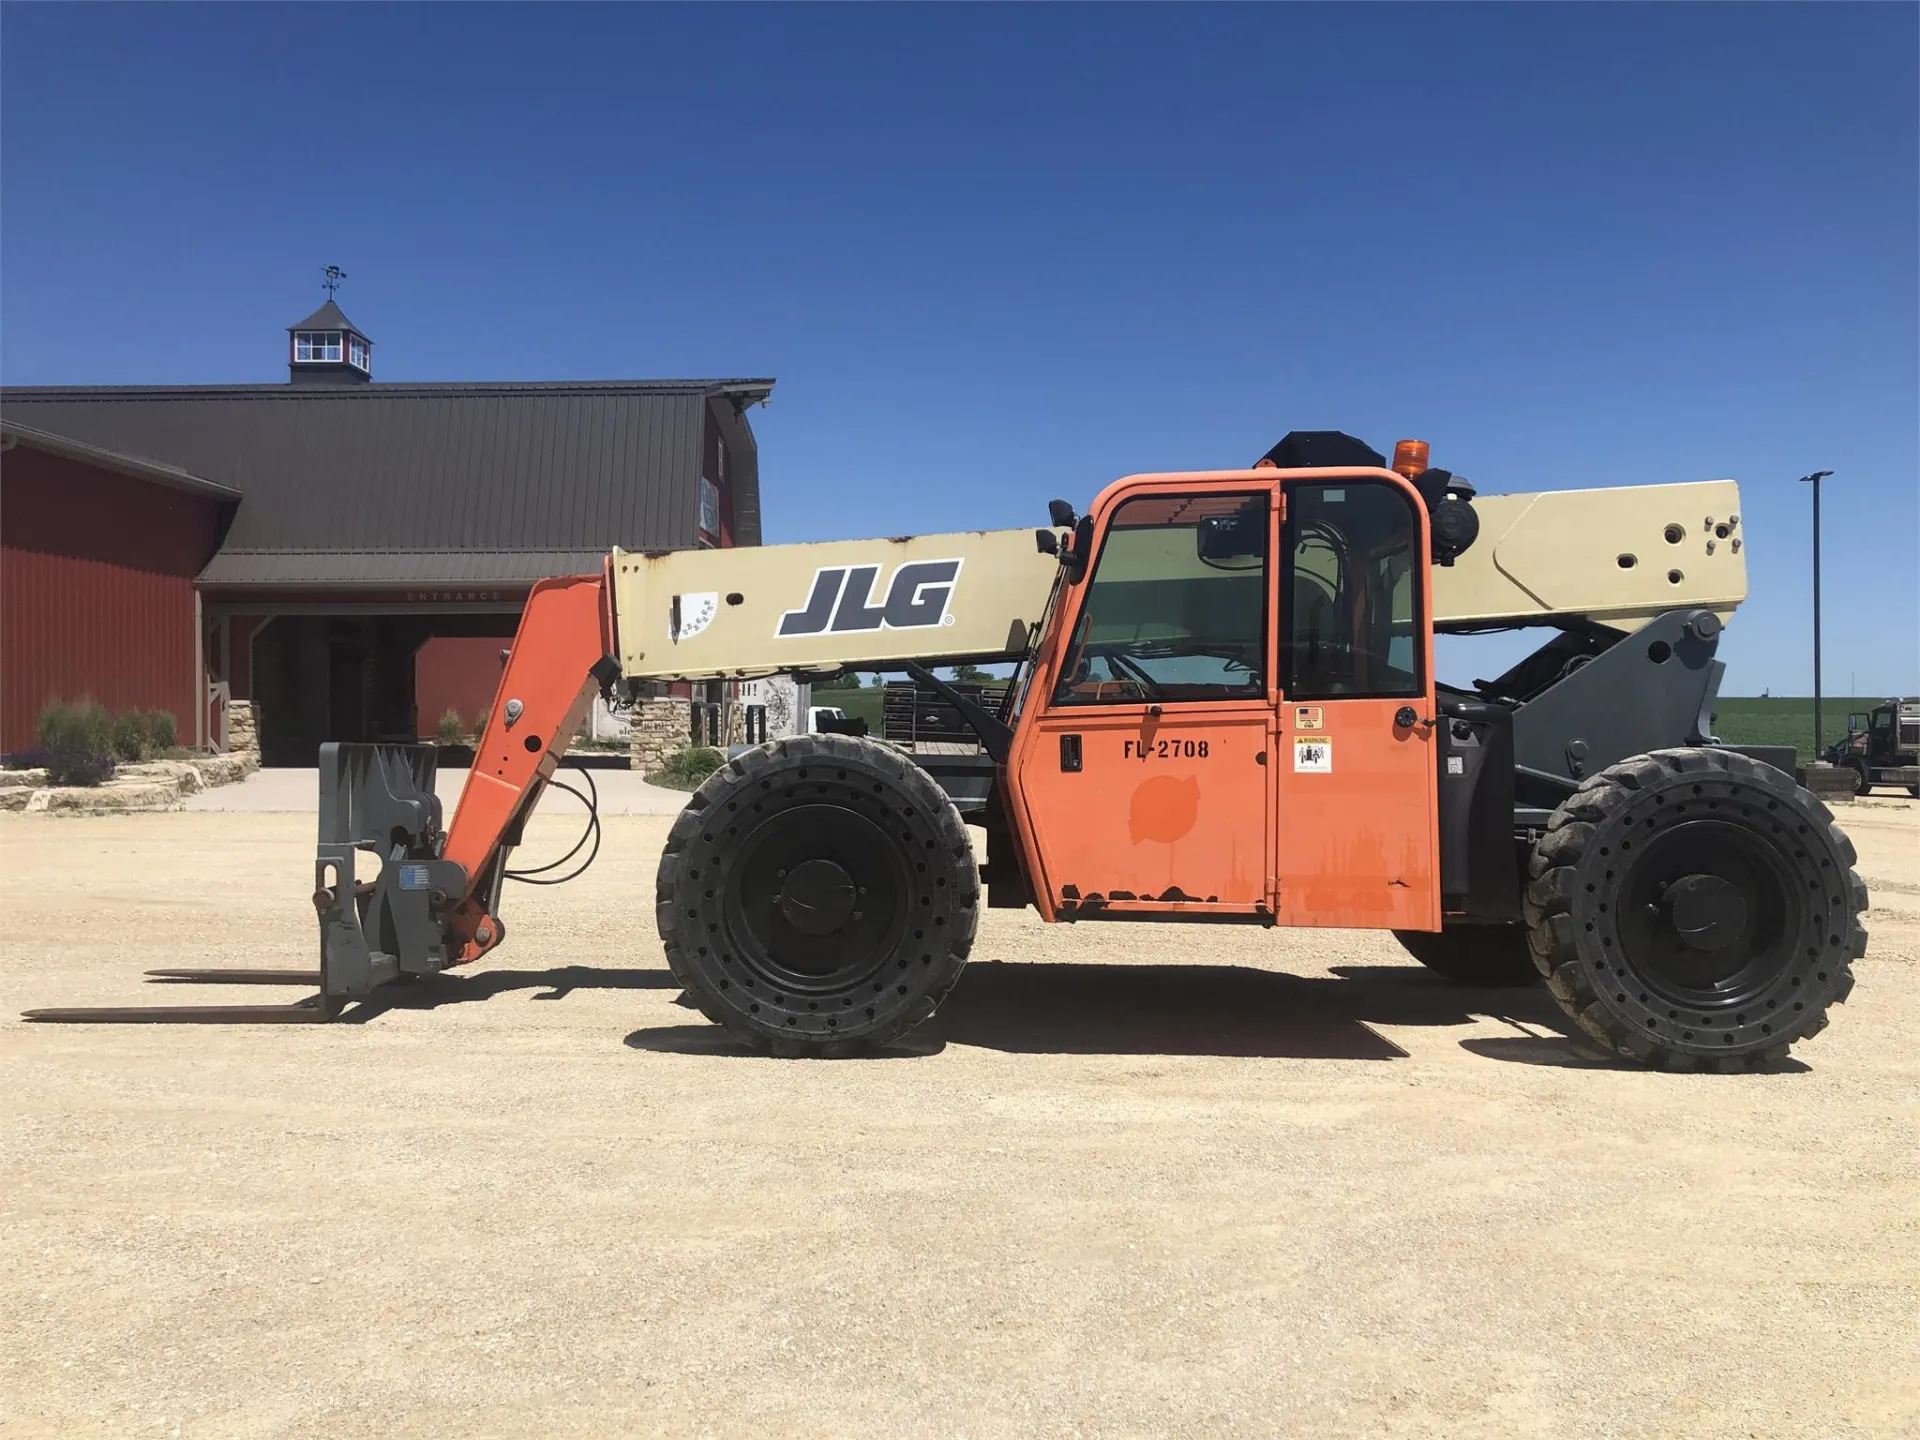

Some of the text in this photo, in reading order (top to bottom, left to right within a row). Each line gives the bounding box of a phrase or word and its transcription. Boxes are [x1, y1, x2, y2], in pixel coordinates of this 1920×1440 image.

[407, 592, 501, 601] ENTRANCE
[776, 558, 963, 637] JLG
[1124, 740, 1209, 759] FL-2708
